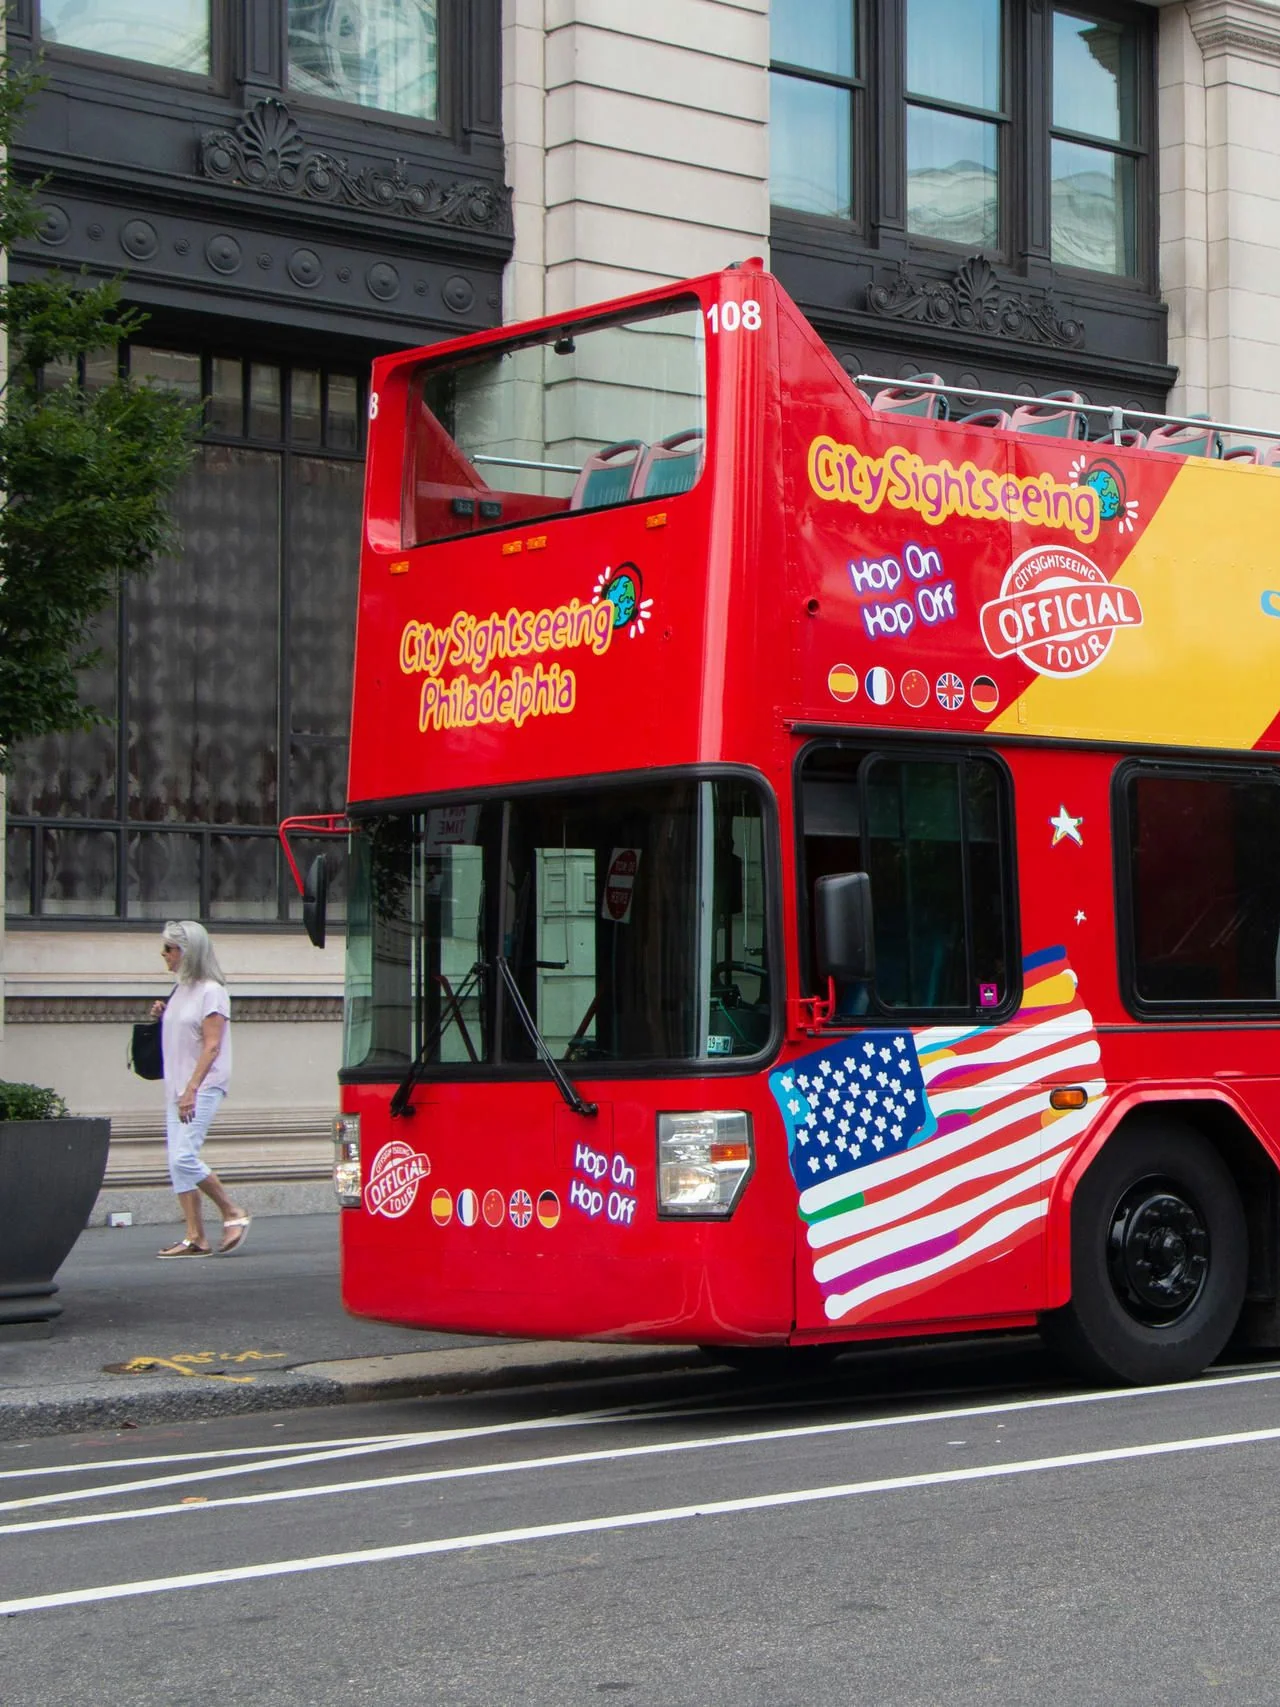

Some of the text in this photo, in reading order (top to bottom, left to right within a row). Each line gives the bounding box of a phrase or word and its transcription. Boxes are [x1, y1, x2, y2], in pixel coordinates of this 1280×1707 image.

[706, 299, 762, 334] 108
[850, 543, 942, 593] Hop On
[863, 583, 956, 640] Hop Off
[999, 590, 1135, 645] OFFICIAL
[1045, 635, 1105, 669] TOUR
[419, 662, 577, 732] Philadelphia
[370, 1158, 427, 1205] OFFICIAL
[575, 1143, 635, 1187] Hop On
[390, 1186, 415, 1211] TOUR
[570, 1180, 637, 1224] Hop Off
